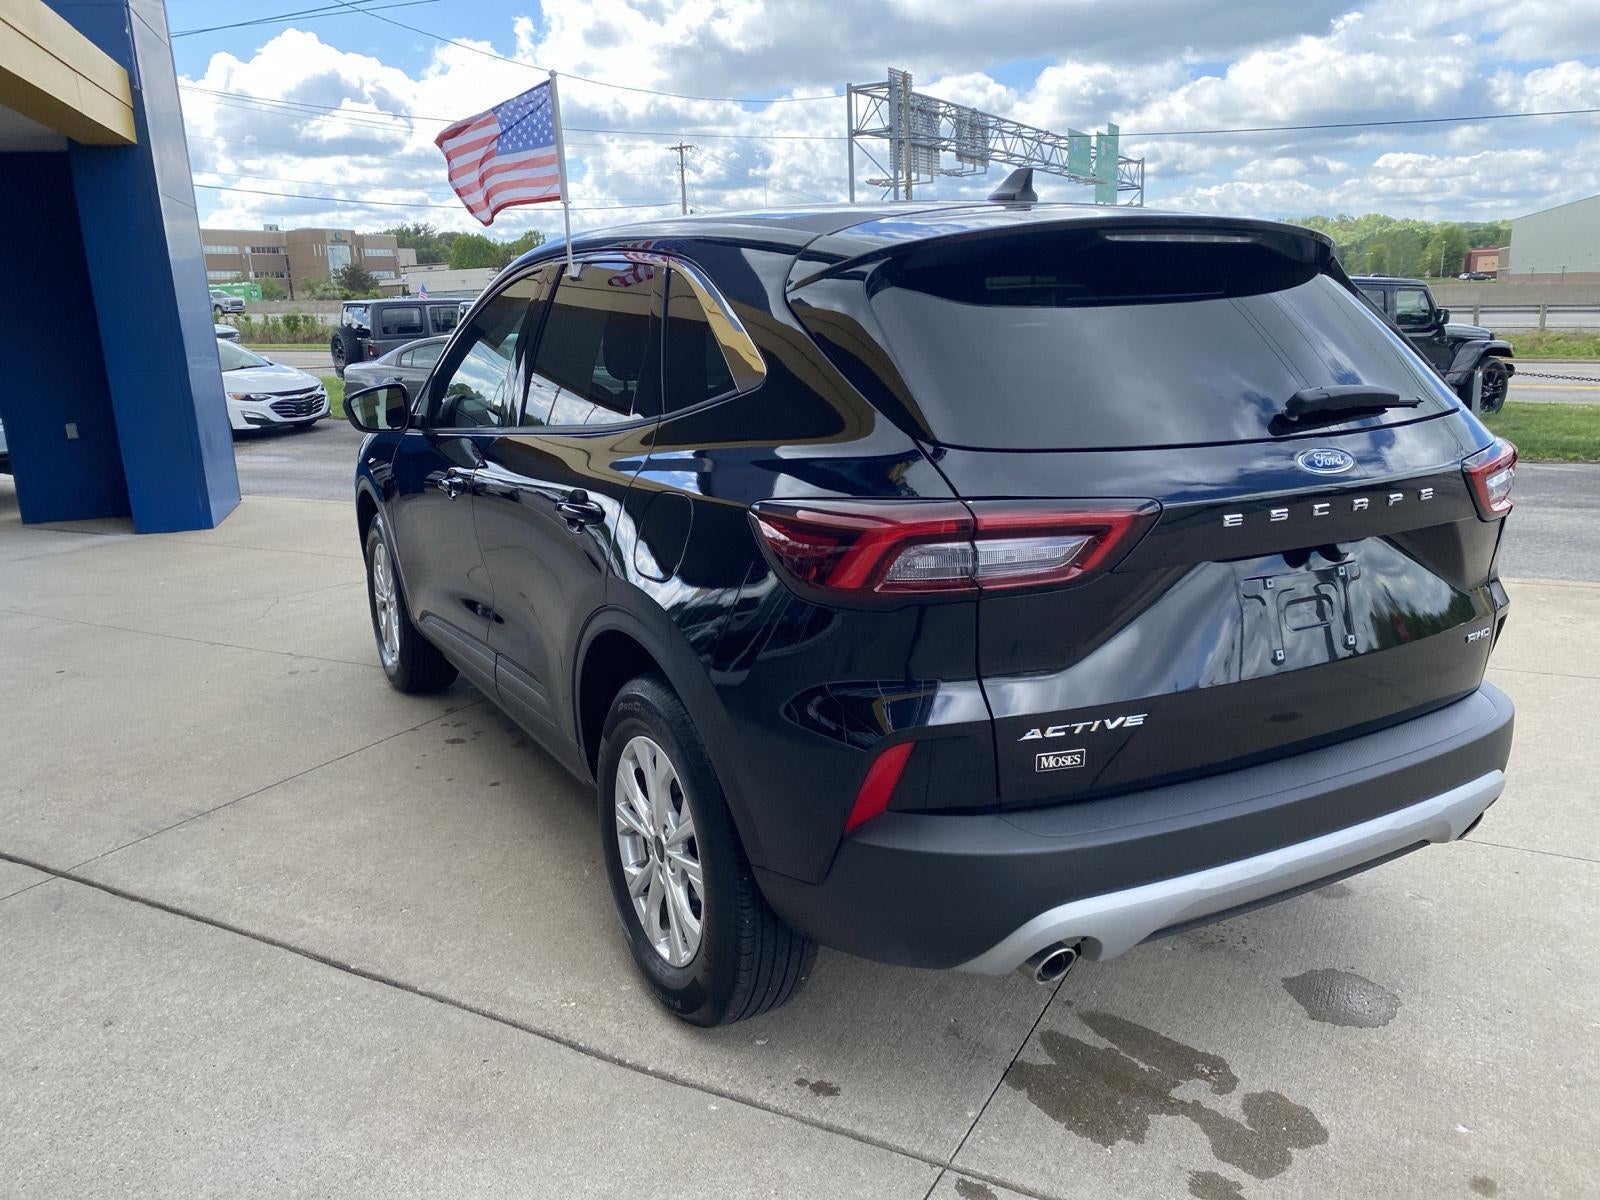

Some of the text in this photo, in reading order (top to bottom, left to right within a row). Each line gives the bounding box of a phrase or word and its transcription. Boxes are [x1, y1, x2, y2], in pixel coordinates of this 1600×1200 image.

[1313, 451, 1344, 467] Ford
[1223, 487, 1434, 527] ESCAPE
[1017, 713, 1148, 742] ACTIVE
[1040, 754, 1081, 769] MOSES
